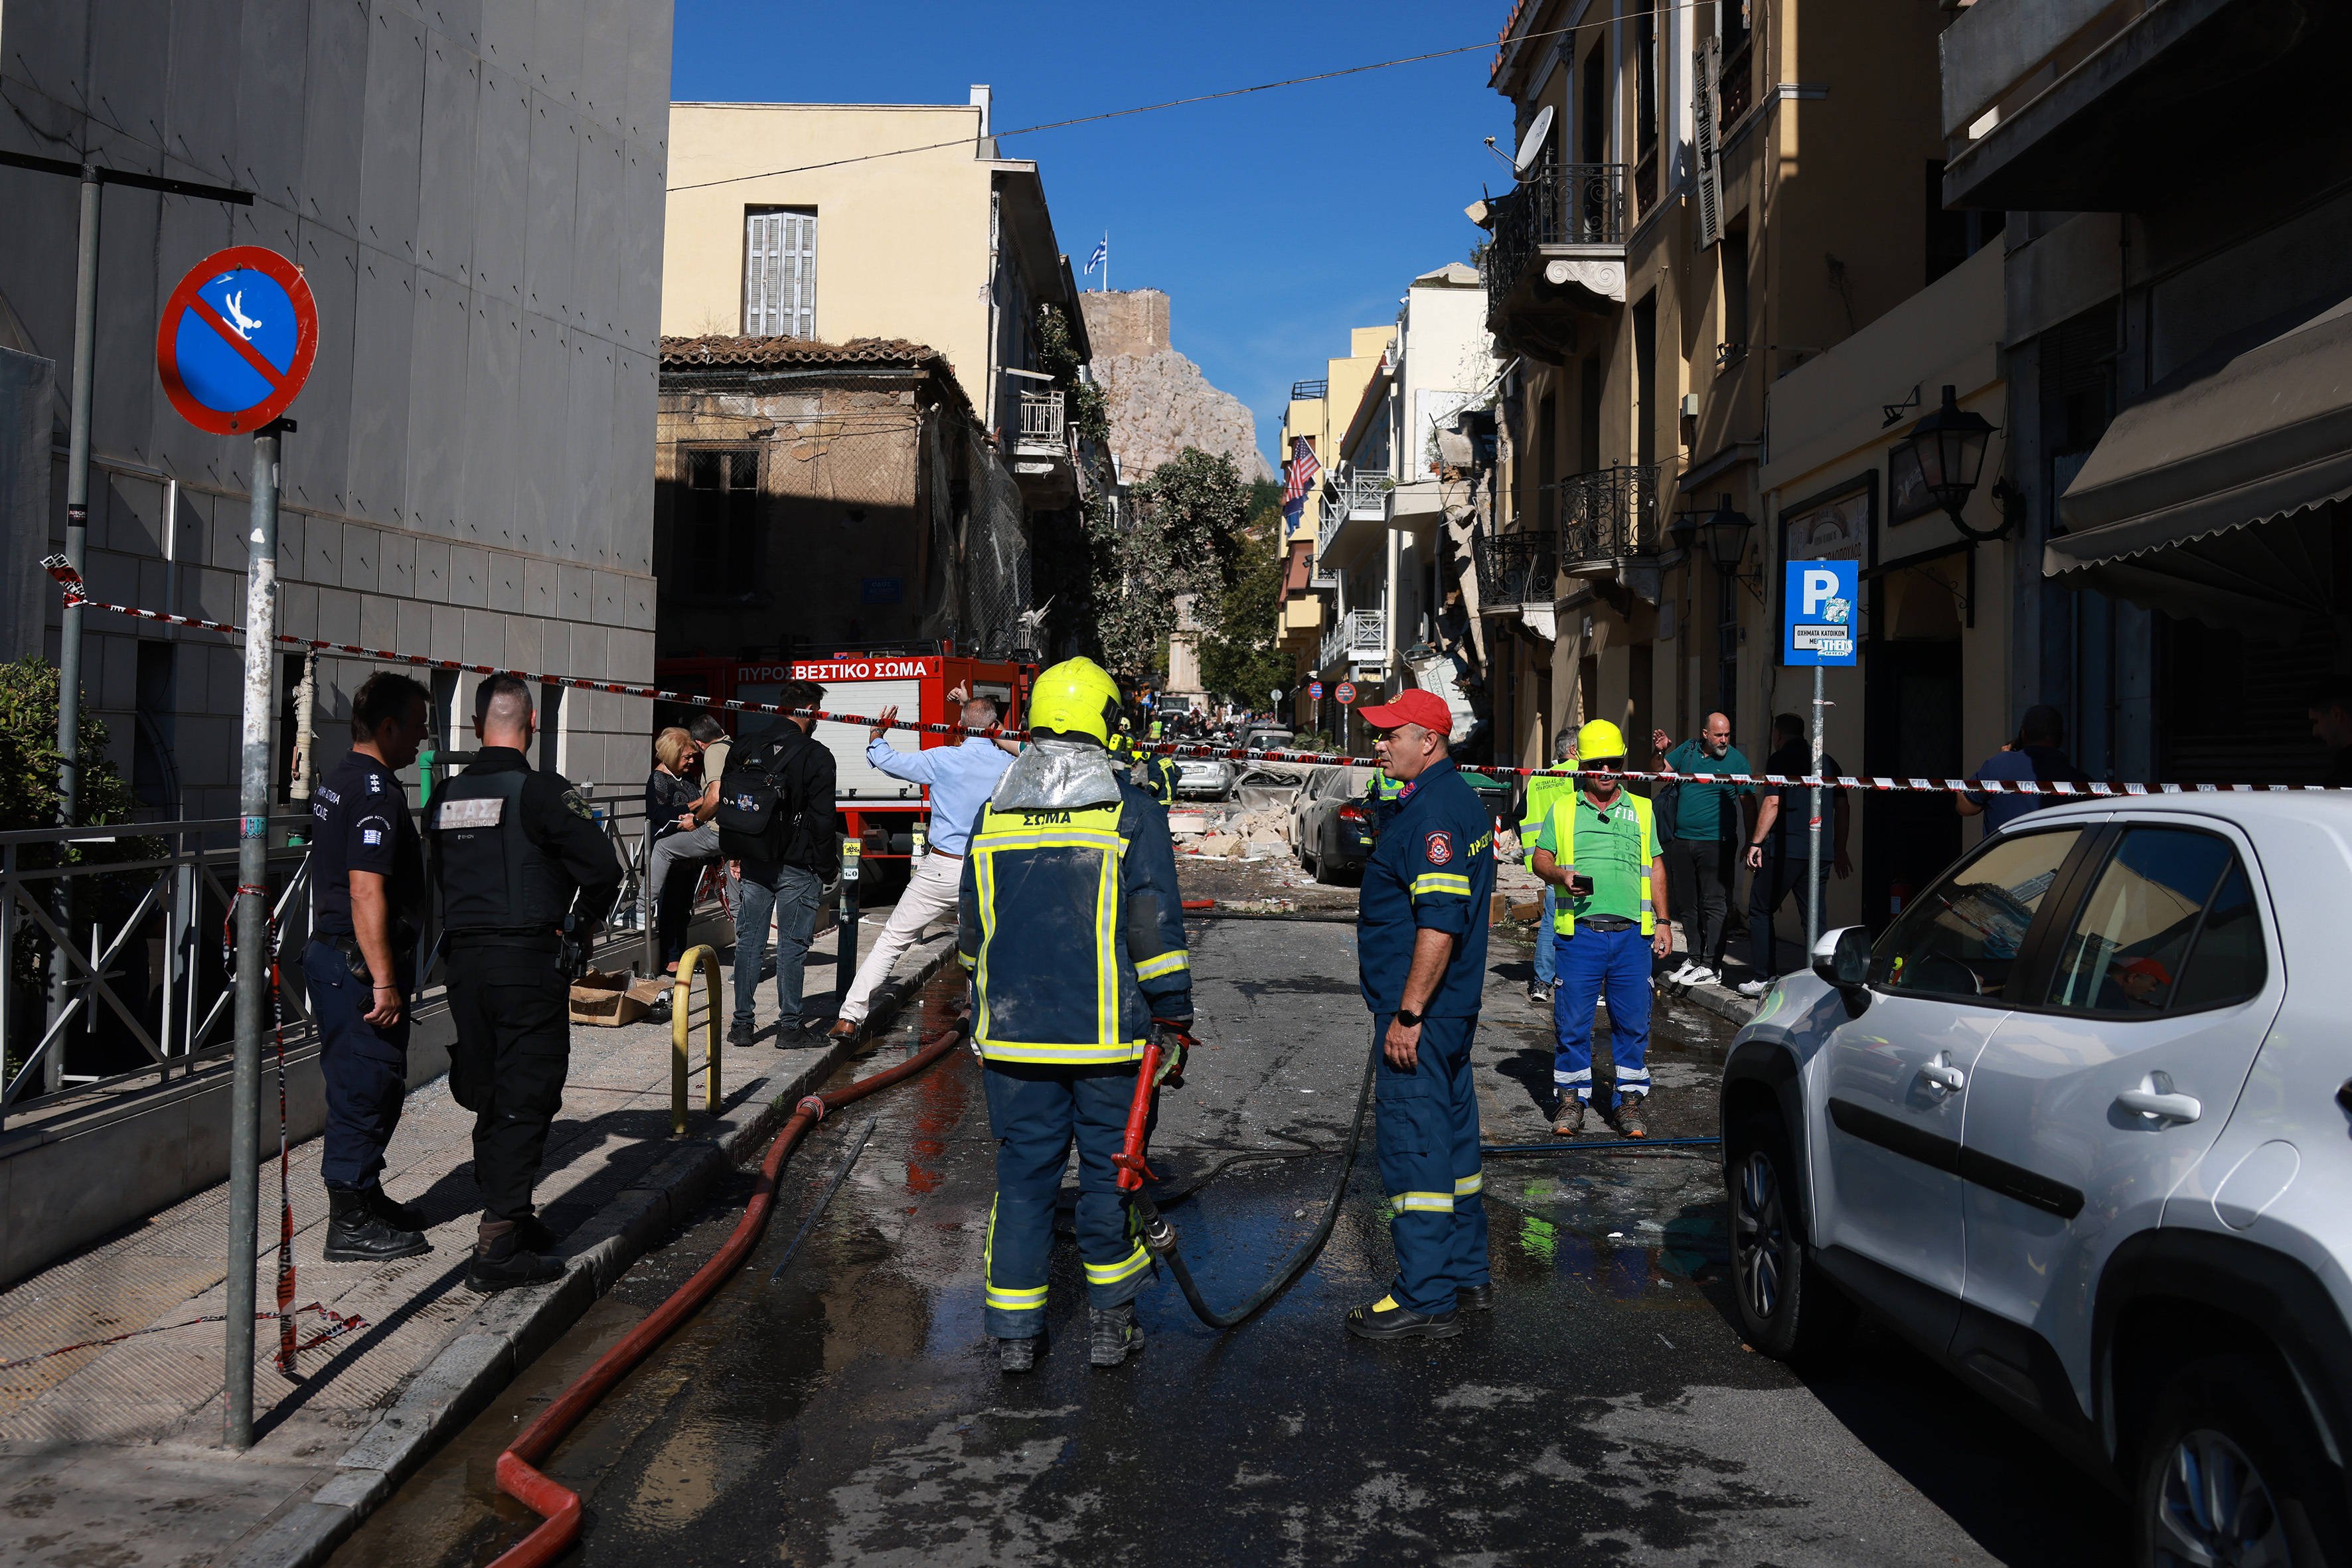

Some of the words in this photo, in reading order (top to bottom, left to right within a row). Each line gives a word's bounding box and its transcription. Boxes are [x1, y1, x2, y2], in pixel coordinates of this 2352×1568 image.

[1803, 570, 1840, 615] P
[1816, 639, 1853, 651] ATHENS
[738, 663, 870, 681] ΠΥΡΟΣΒΕΣΤΙΚΟ
[874, 661, 927, 678] ΣΩΜΑ
[833, 714, 886, 727] ΔΗΜΟΤΙΚΗ
[890, 720, 948, 734] ΑΣΤΥΝΟΜΙΑ
[952, 727, 994, 738] ΑΘΗΝΩΝ
[1178, 745, 1232, 757] ΔΗΜΟΤΙΚΗ
[1237, 751, 1295, 762] ΑΣΤΥΝΟΜΙΑ
[1301, 755, 1344, 765] ΑΘΗΝΩΝ
[1023, 811, 1071, 826] ΣΩΜΑ
